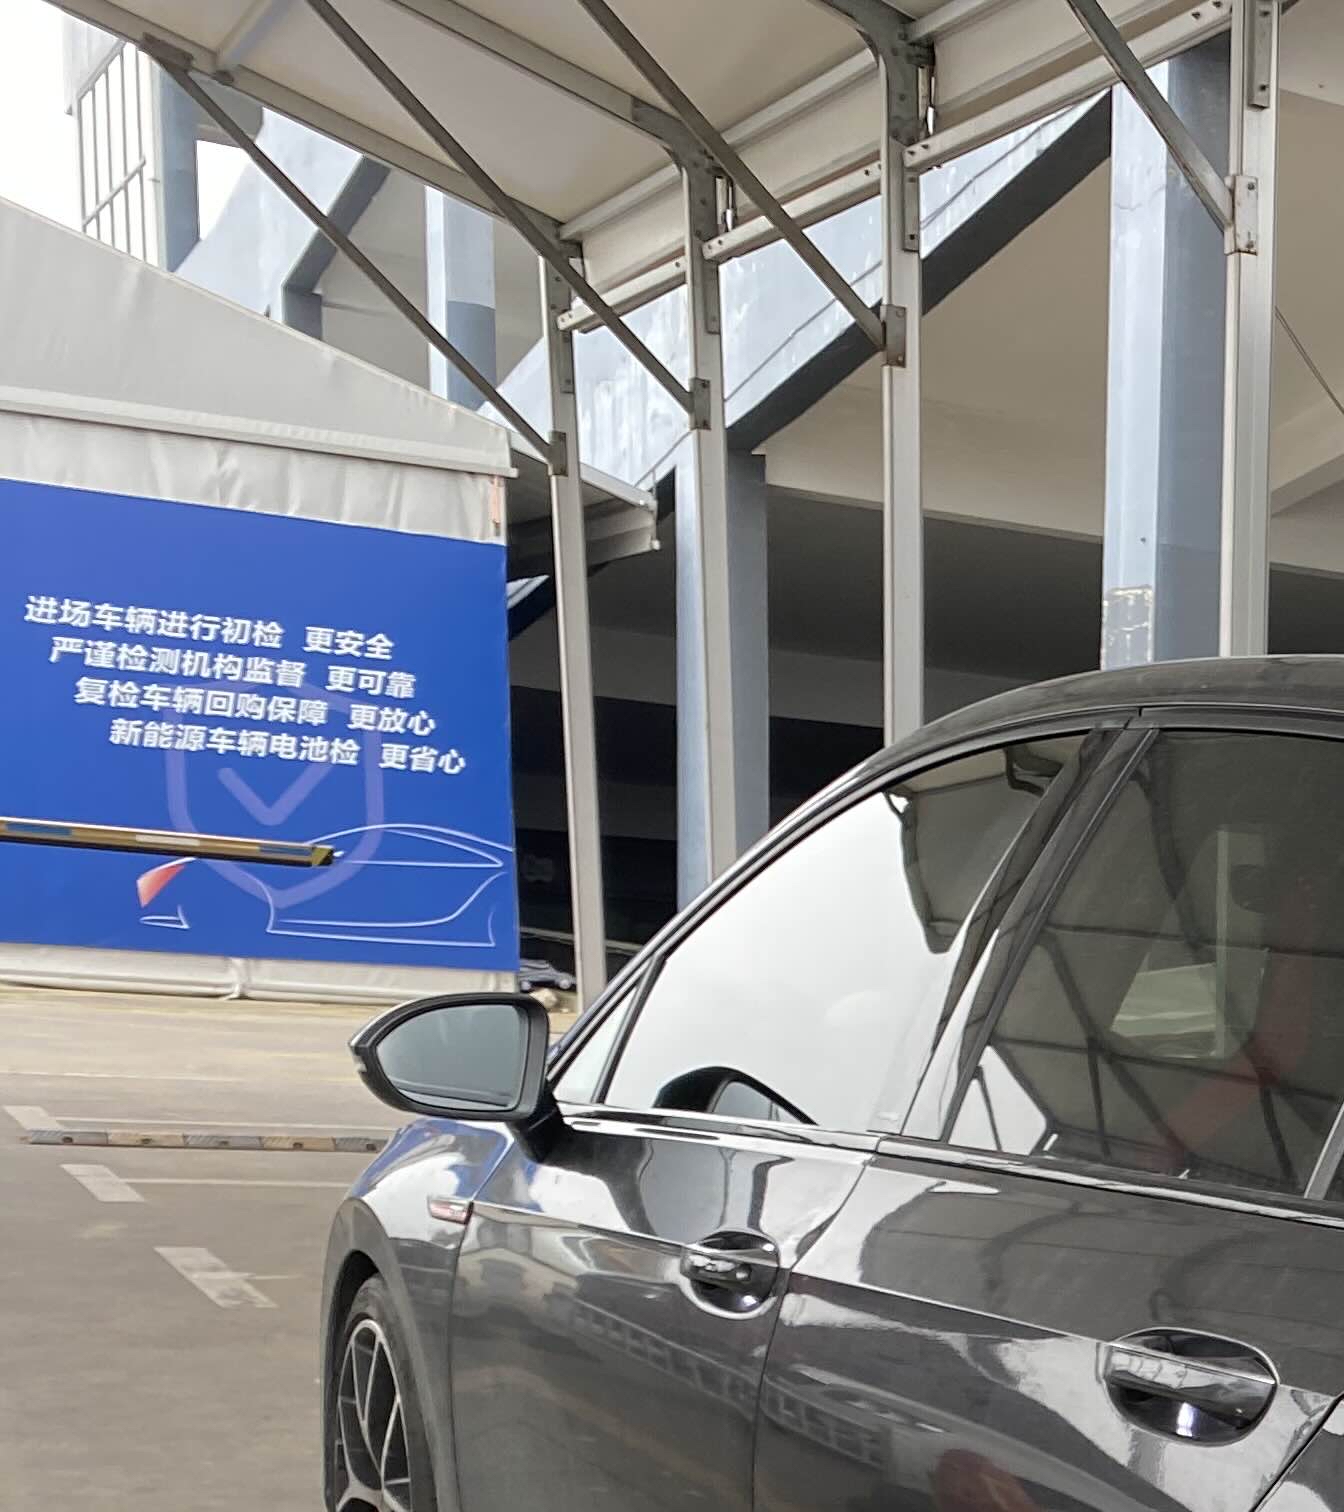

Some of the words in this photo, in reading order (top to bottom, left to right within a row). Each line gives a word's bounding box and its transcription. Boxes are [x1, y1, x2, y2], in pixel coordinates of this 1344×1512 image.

[24, 596, 284, 648] 进场车辆进行初检
[302, 625, 394, 660] 更安全
[48, 636, 307, 688] 严谨检测机构监督
[325, 664, 417, 699] 更可靠
[74, 676, 328, 727] 复检车辆回购保障
[347, 704, 436, 736] 更放心
[109, 718, 361, 765] 新能源车辆电池检
[378, 743, 467, 775] 更省心
